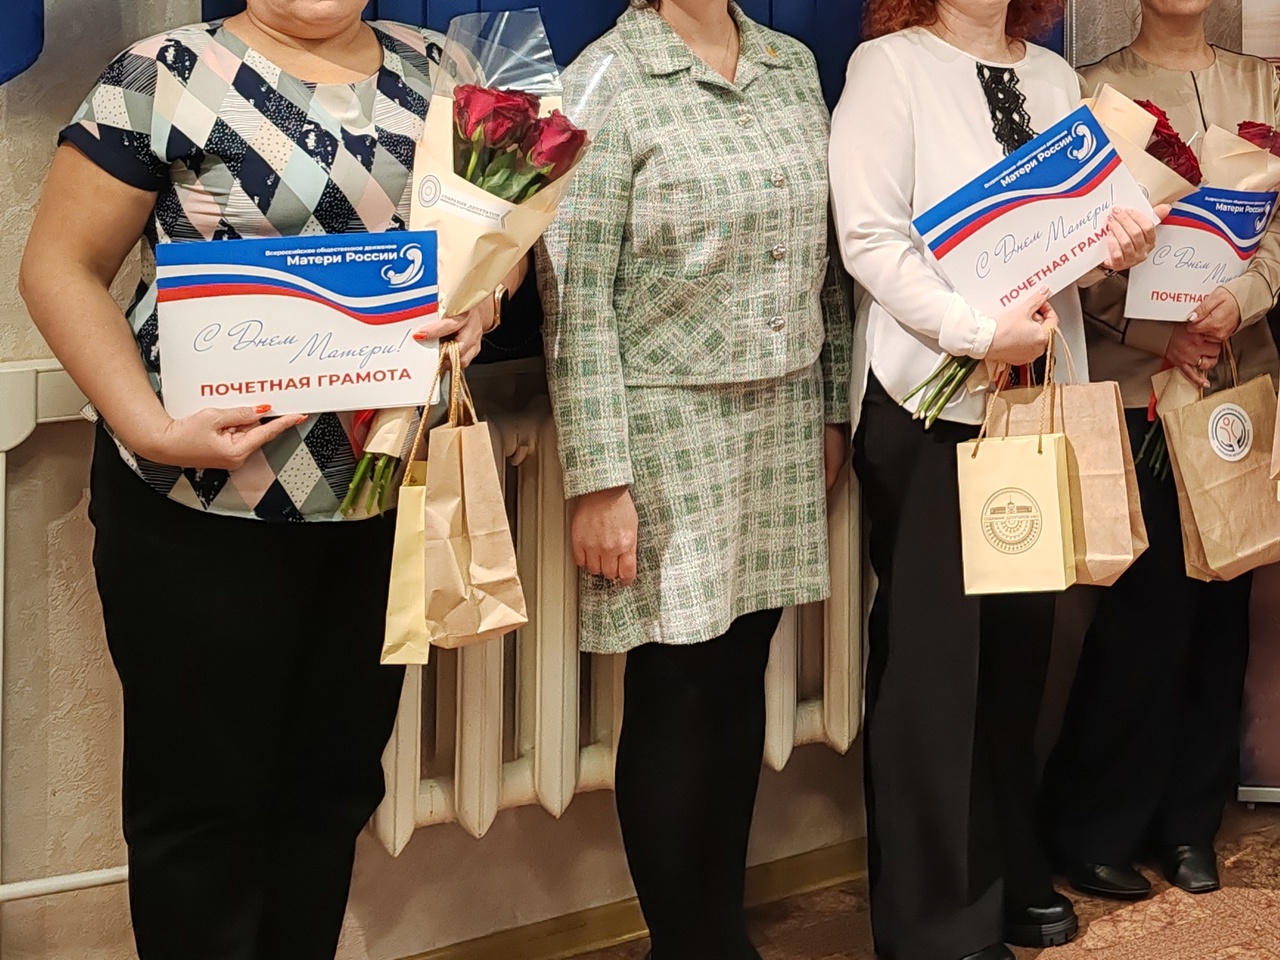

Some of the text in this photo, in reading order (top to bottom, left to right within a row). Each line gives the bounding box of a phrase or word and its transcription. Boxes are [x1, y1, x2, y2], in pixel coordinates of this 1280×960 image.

[1000, 158, 1038, 188] Матери
[1037, 135, 1073, 162] России
[975, 250, 991, 279] С
[1045, 183, 1115, 252] Матери!
[286, 251, 398, 266] Матери России
[999, 224, 1110, 308] ПОЧЕТНАЯ ГРАМ
[1152, 244, 1172, 266] С
[193, 323, 222, 352] С
[289, 328, 412, 370] Матери!
[200, 368, 412, 397] ПОЧЕТНАЯ ГРАМОТА
